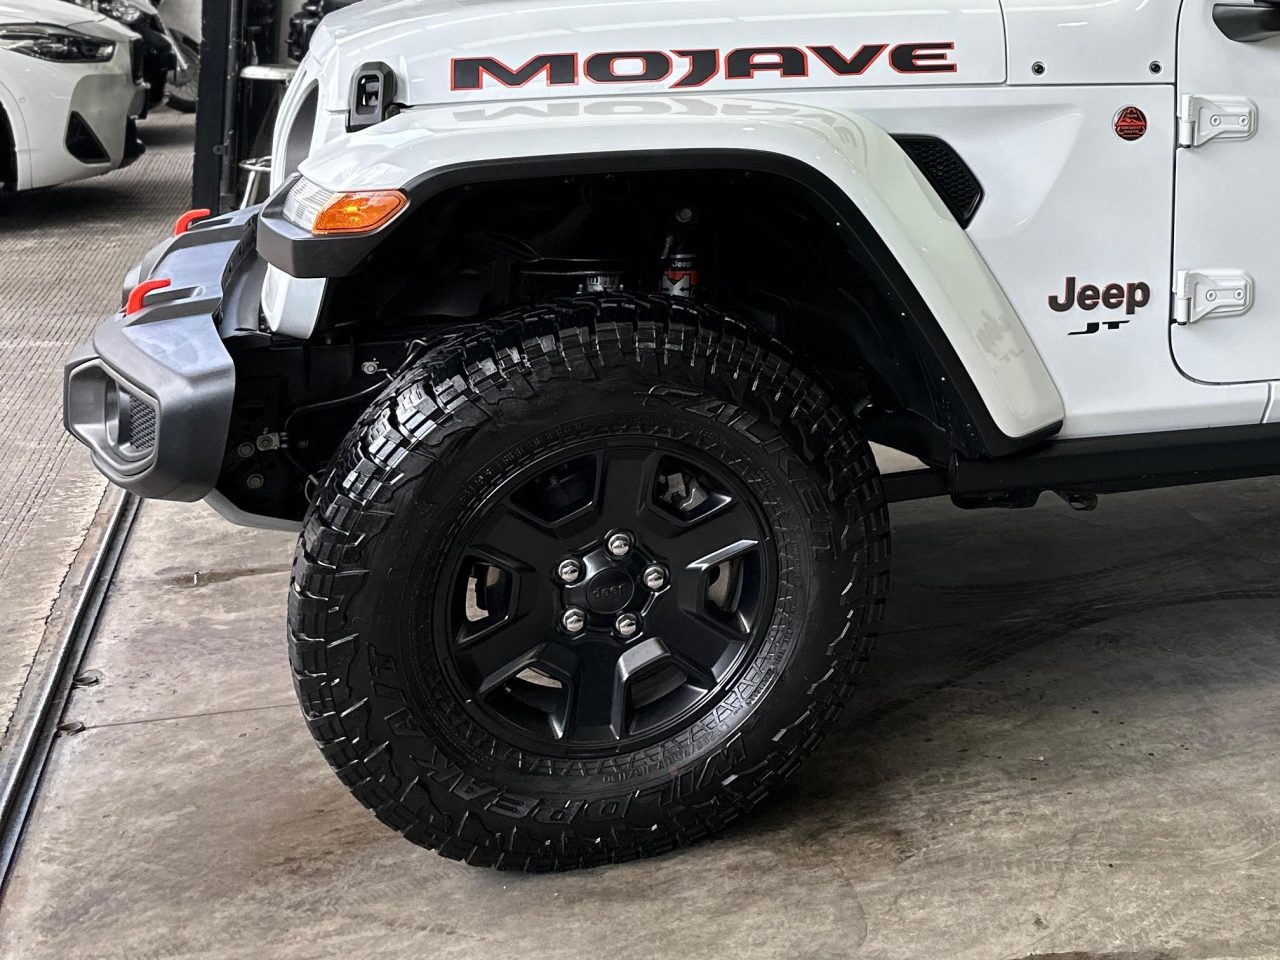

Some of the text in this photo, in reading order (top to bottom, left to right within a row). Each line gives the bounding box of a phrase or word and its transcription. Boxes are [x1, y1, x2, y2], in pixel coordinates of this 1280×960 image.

[450, 41, 958, 91] MOJAVE
[672, 260, 692, 269] Jeep
[1047, 276, 1151, 315] Jeep
[1066, 320, 1131, 336] JT
